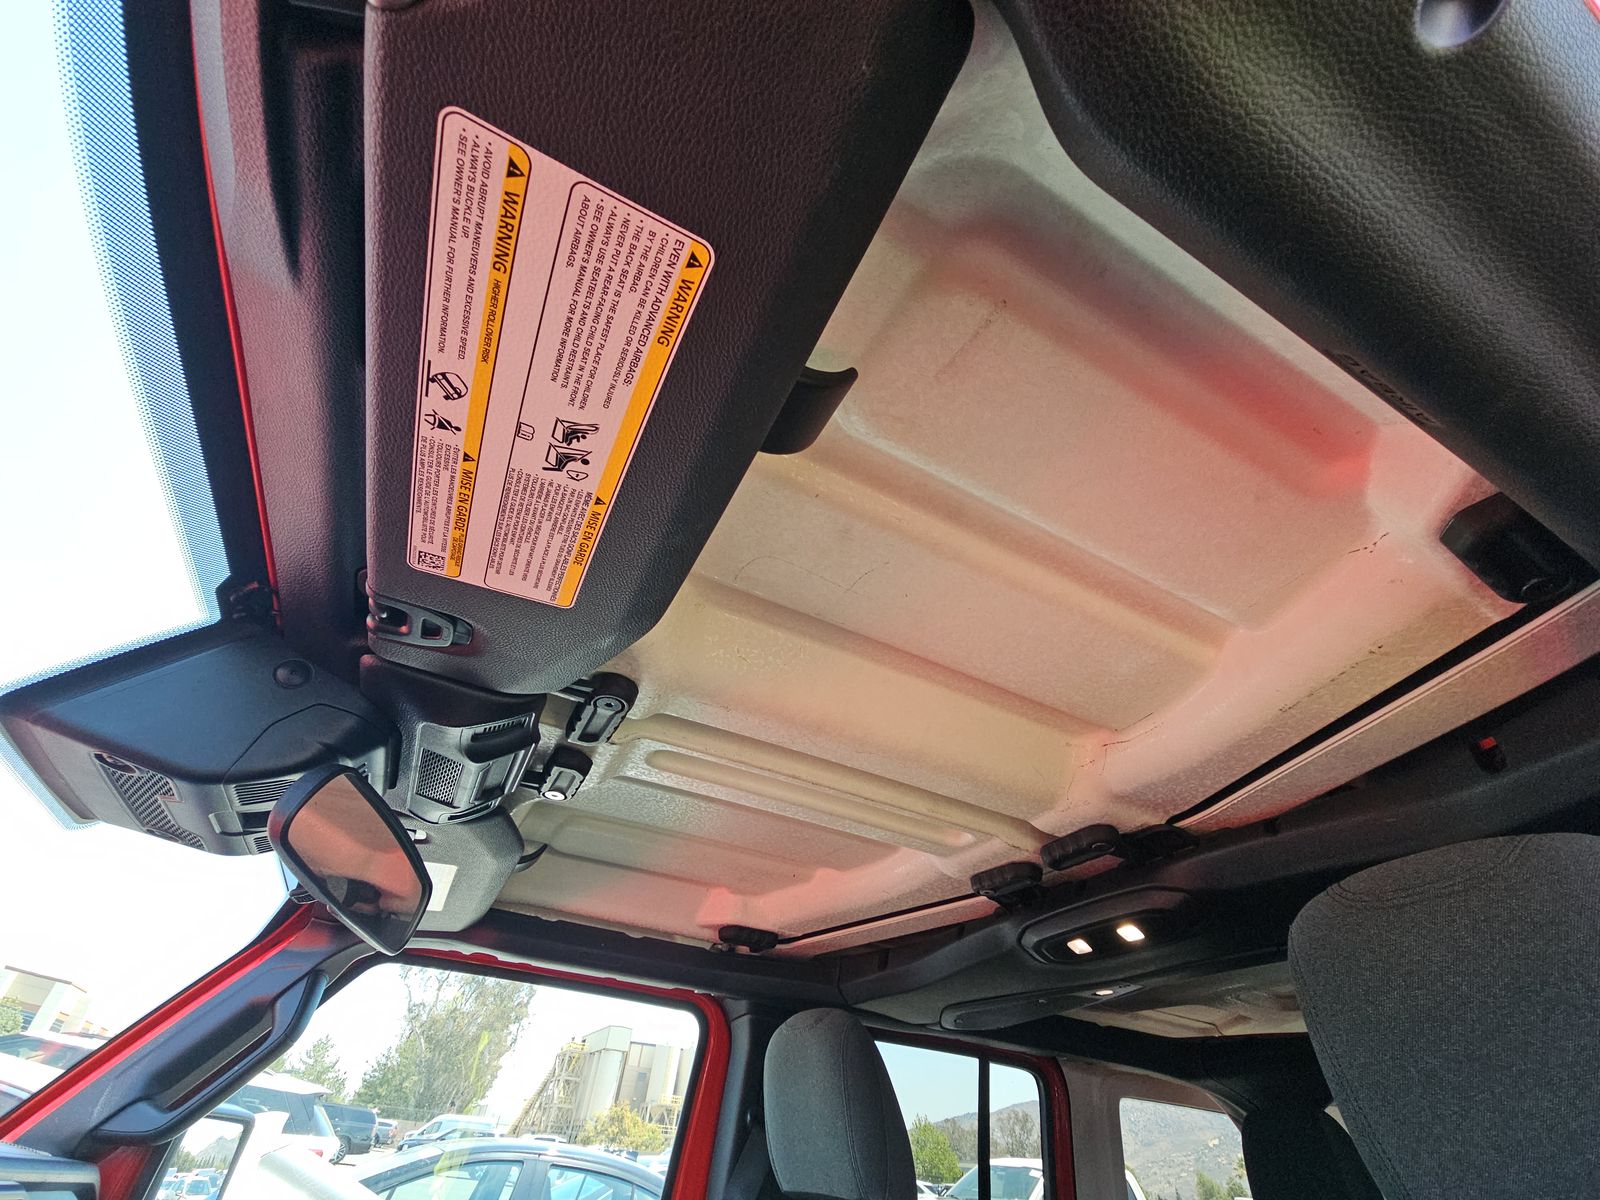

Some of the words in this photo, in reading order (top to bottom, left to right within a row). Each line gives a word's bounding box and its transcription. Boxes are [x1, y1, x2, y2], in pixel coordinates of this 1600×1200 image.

[457, 133, 467, 156] SEE
[467, 139, 479, 184] ALWAYS
[480, 146, 492, 179] AVOID
[452, 156, 464, 205] OWNER'S
[462, 183, 474, 224] BUCKLE
[475, 180, 488, 221] ABRUPT
[576, 194, 590, 228] ABOUT
[592, 202, 603, 222] SEE
[448, 205, 459, 245] MANUAL
[460, 224, 469, 240] UP.
[492, 188, 519, 274] WARNING
[600, 209, 616, 247] ALWAYS
[615, 216, 630, 247] NEVER
[631, 223, 643, 243] THE
[645, 230, 655, 244] BY
[446, 245, 455, 264] FOR
[468, 220, 482, 275] MANEUVERS
[565, 228, 581, 270] AIRBAGS.
[581, 222, 598, 264] OWNER'S
[595, 246, 606, 265] USE
[623, 242, 637, 268] BACK
[639, 243, 651, 261] THE
[666, 238, 684, 269] EVEN
[607, 265, 615, 273] A
[609, 247, 620, 266] PUT
[647, 236, 668, 279] CHILDREN
[442, 264, 453, 303] FURTHER
[466, 275, 474, 294] AND
[572, 264, 587, 298] MANUAL
[582, 265, 600, 310] SEATBELTS
[616, 267, 629, 289] SEAT
[628, 261, 645, 295] AIRBAG.
[641, 279, 652, 298] CAN
[656, 268, 673, 296] WITH
[489, 278, 501, 308] HIGHER
[592, 273, 613, 325] REAR-FACING
[608, 298, 619, 314] THE
[613, 289, 622, 298] IS
[637, 297, 646, 309] BE
[460, 293, 472, 336] EXCESSIVE
[567, 298, 578, 315] FOR
[578, 309, 588, 326] AND
[656, 276, 694, 347] WARNING
[437, 303, 448, 355] INFORMATION.
[483, 308, 496, 347] ROLLOVER
[562, 315, 573, 337] MORE
[599, 314, 614, 342] SAFEST
[627, 309, 642, 335] KILLED
[637, 295, 663, 347] ADVANCED
[457, 335, 466, 361] SPEED.
[572, 326, 583, 348] CHILD
[585, 324, 597, 347] CHILD
[623, 335, 632, 347] OR
[480, 346, 489, 364] RISK
[550, 337, 567, 382] INFORMATION
[580, 346, 591, 365] SEAT
[592, 342, 605, 365] PLACE
[611, 346, 629, 383] SERIOUSLY
[622, 346, 643, 387] AIRBAGS:
[560, 348, 577, 390] RESTRAINTS.
[573, 372, 583, 386] THE
[578, 364, 585, 372] IN
[587, 365, 597, 379] FOR
[567, 385, 579, 407] FRONT.
[577, 379, 593, 411] CHILDREN.
[602, 382, 616, 409] INJURED
[421, 435, 427, 443] DE
[427, 438, 435, 468] CONSULTER
[435, 441, 443, 468] TOUJOURS
[451, 446, 459, 465] ÉVITER
[460, 468, 473, 491] MISE
[458, 491, 469, 504] EN
[454, 504, 467, 532] GARDE
[573, 520, 583, 531] DES
[577, 506, 588, 521] AVEC
[585, 510, 601, 530] MISE
[569, 530, 579, 544] SACS
[581, 530, 593, 541] EN
[573, 541, 589, 566] GARDE
